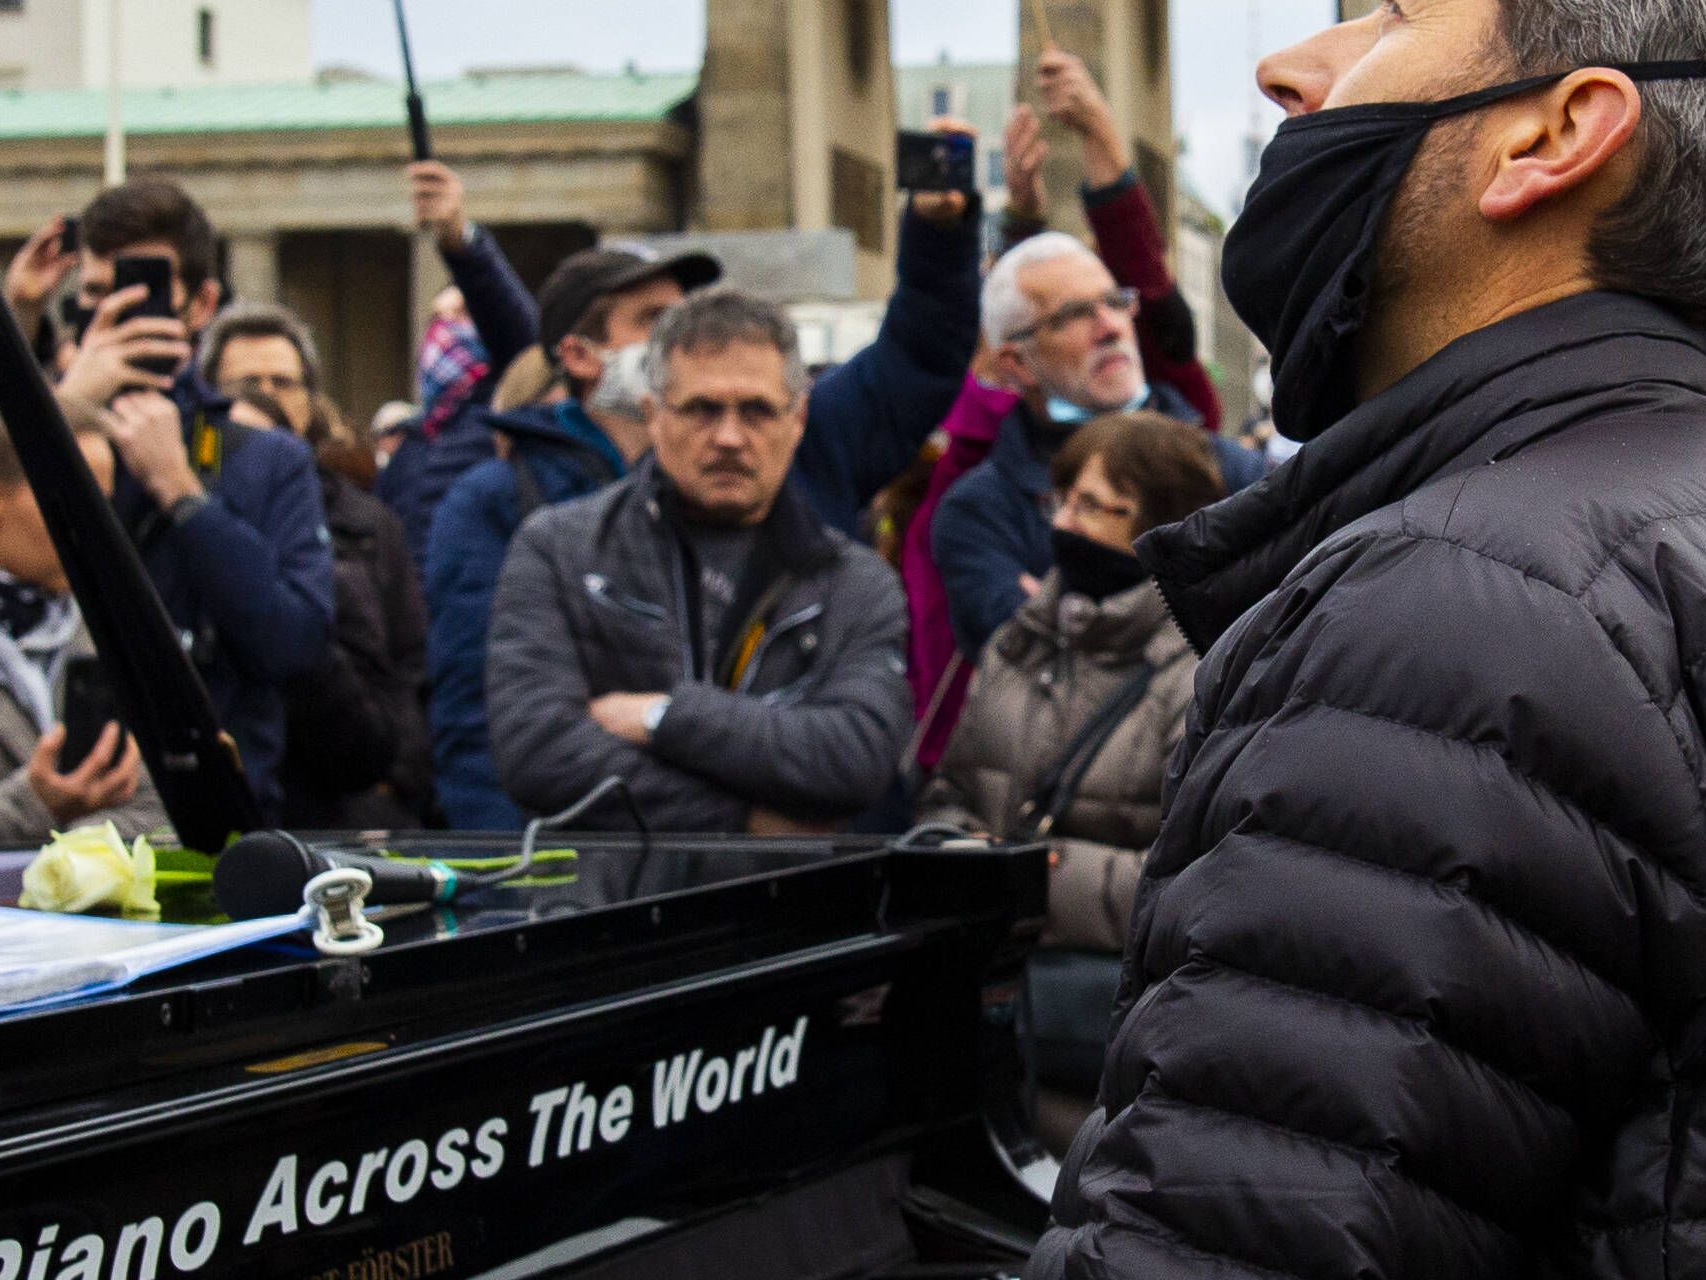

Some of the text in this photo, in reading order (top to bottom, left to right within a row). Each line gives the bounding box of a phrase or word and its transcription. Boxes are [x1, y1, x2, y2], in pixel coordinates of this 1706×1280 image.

[242, 1117, 508, 1245] Across
[528, 1082, 633, 1167] The
[652, 1017, 807, 1128] World
